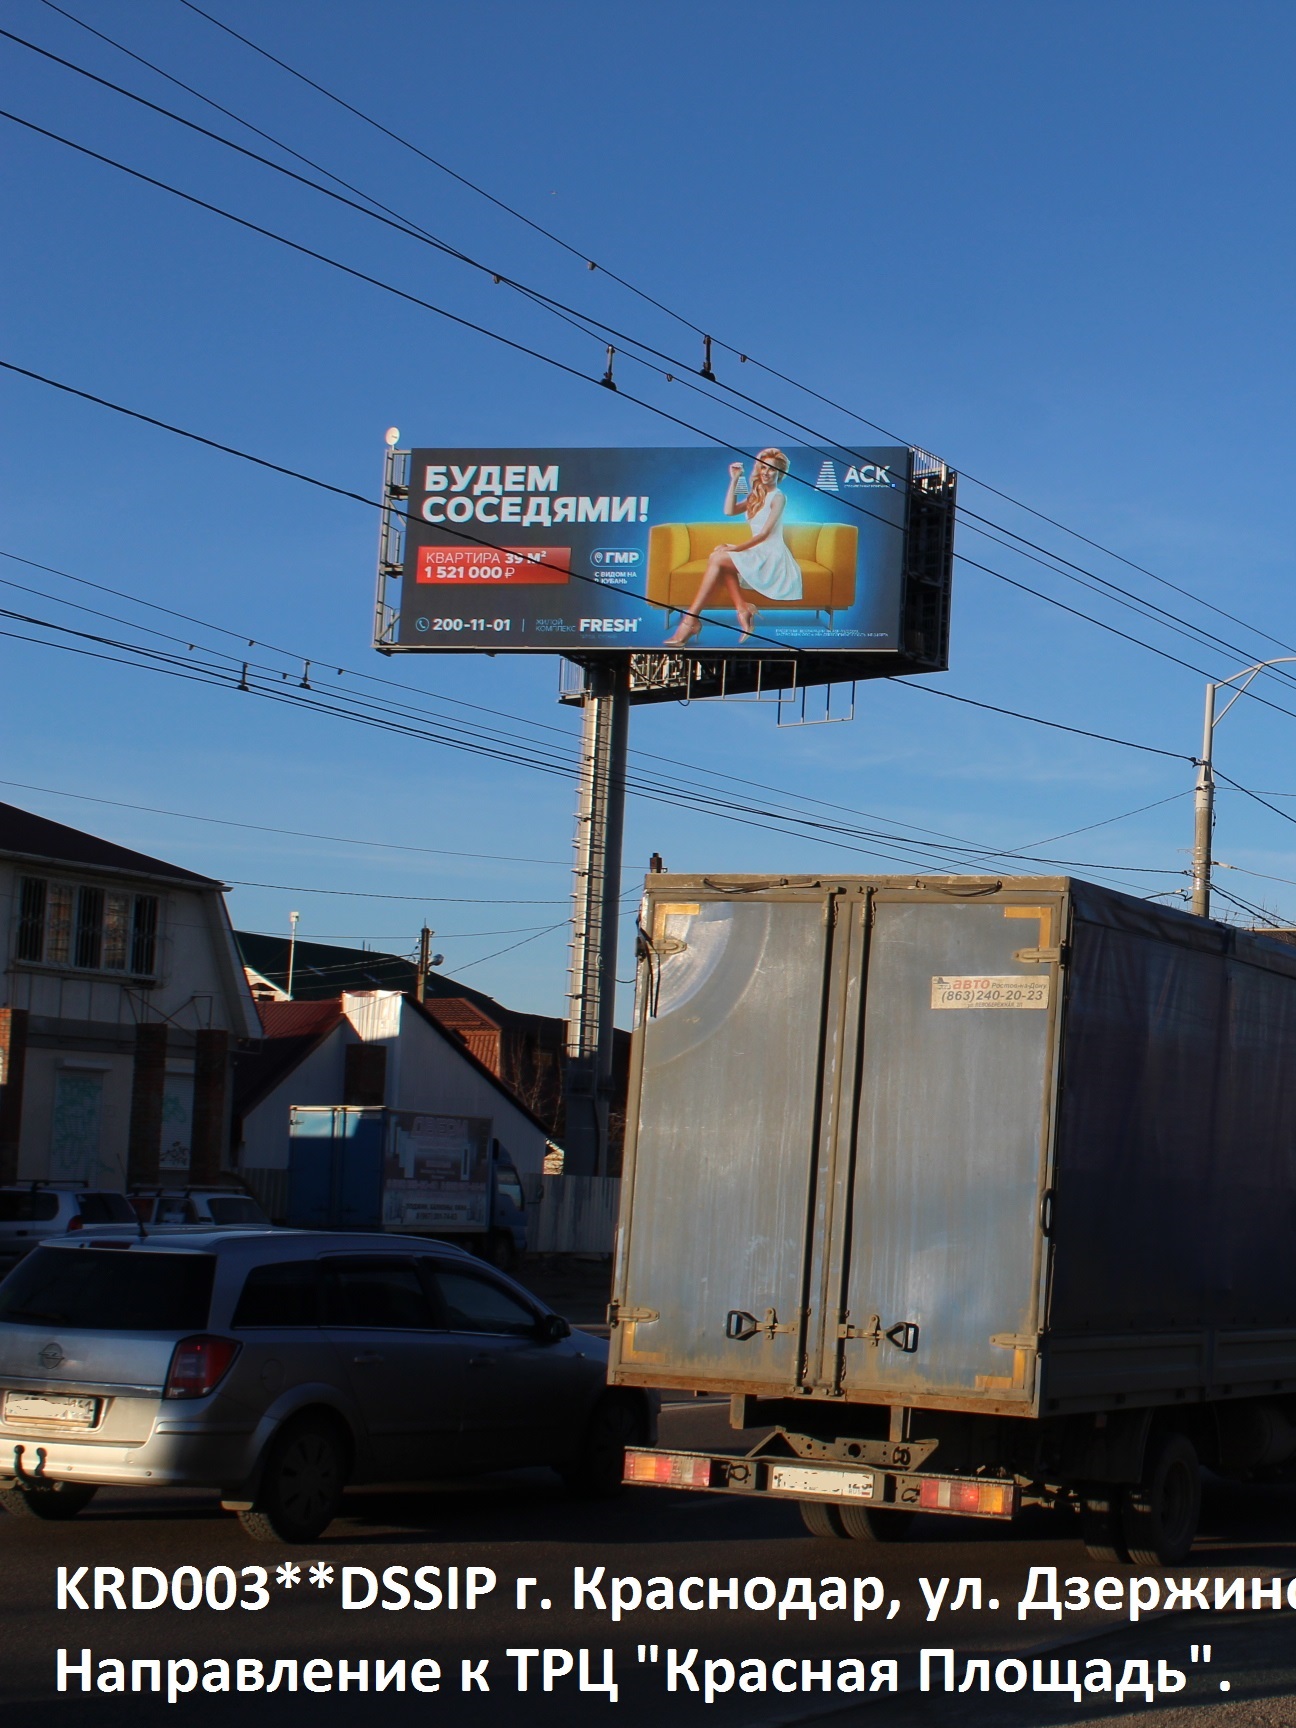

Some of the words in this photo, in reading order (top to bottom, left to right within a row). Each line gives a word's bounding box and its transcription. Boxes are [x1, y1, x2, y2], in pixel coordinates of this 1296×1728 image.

[425, 465, 559, 495] БУДЕМ
[844, 465, 891, 483] АСК
[422, 496, 650, 527] СОСЕДЯМИ!
[426, 552, 501, 563] КВАРТИРА
[505, 553, 524, 564] 39
[605, 551, 640, 564] ГМР
[436, 566, 464, 578] 521
[432, 618, 511, 631] 200-11-01
[953, 979, 990, 990] авто
